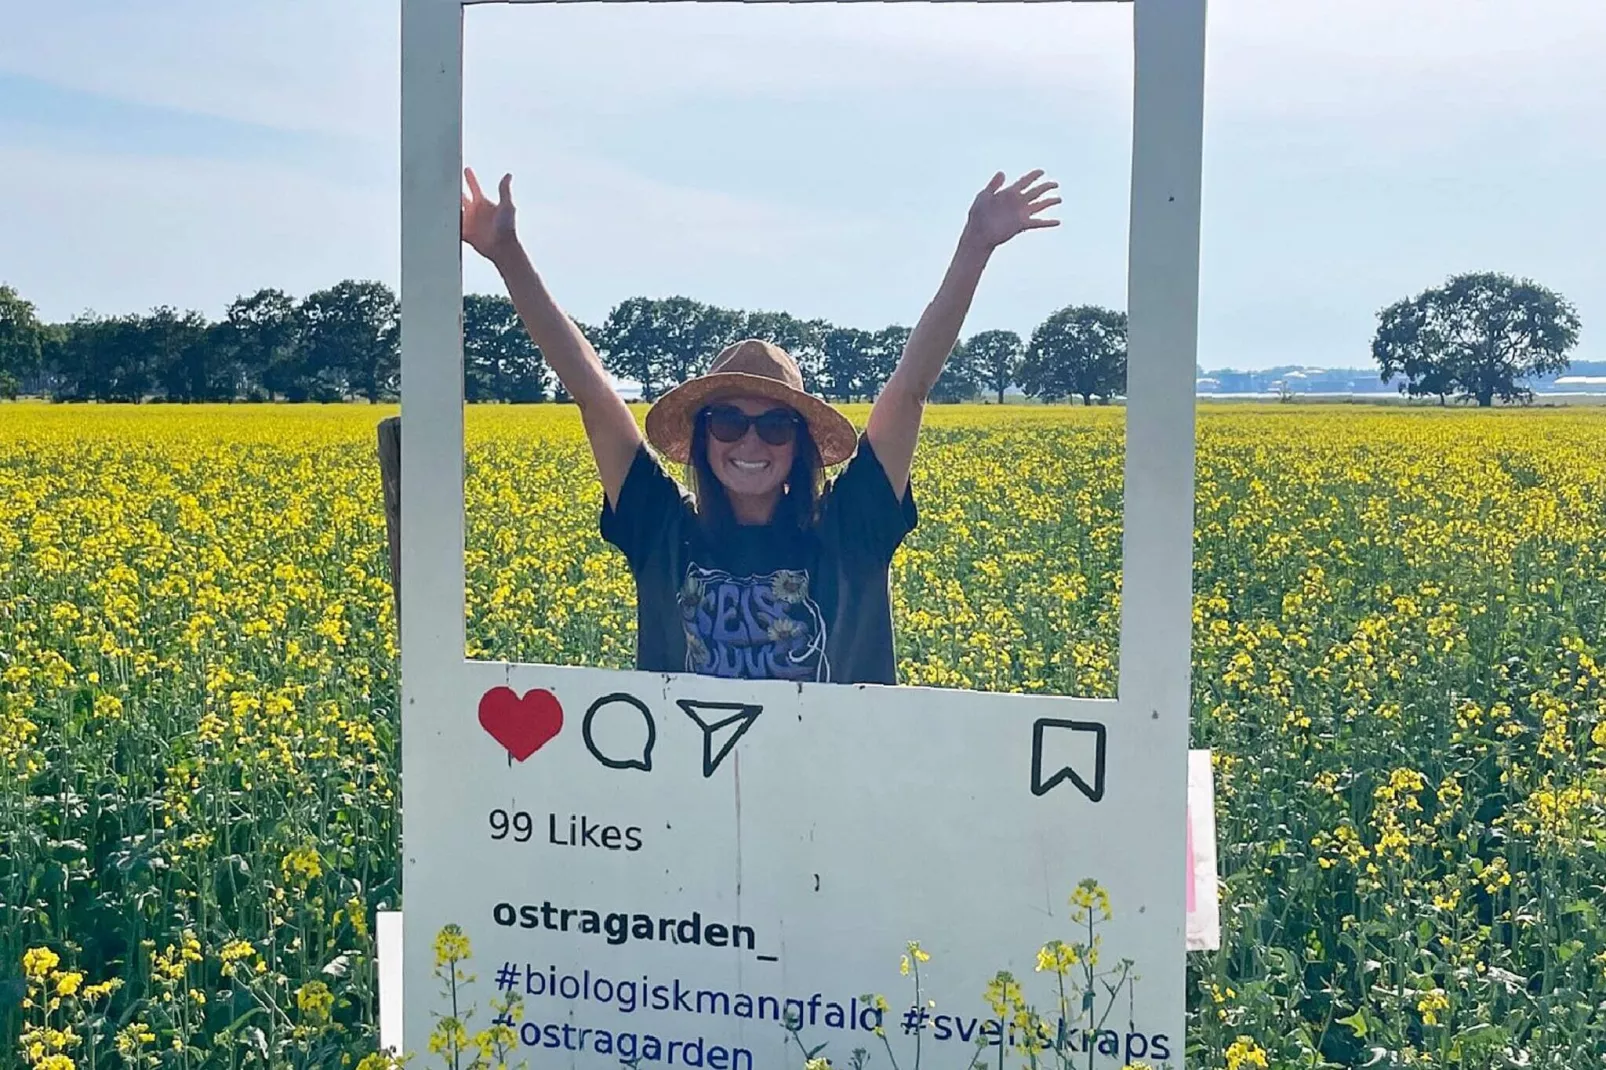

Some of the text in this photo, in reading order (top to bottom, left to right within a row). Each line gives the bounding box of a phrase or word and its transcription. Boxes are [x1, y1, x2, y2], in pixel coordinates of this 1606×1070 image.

[488, 808, 643, 851] 99 Likes
[494, 961, 883, 1032] #biologiskmangfald
